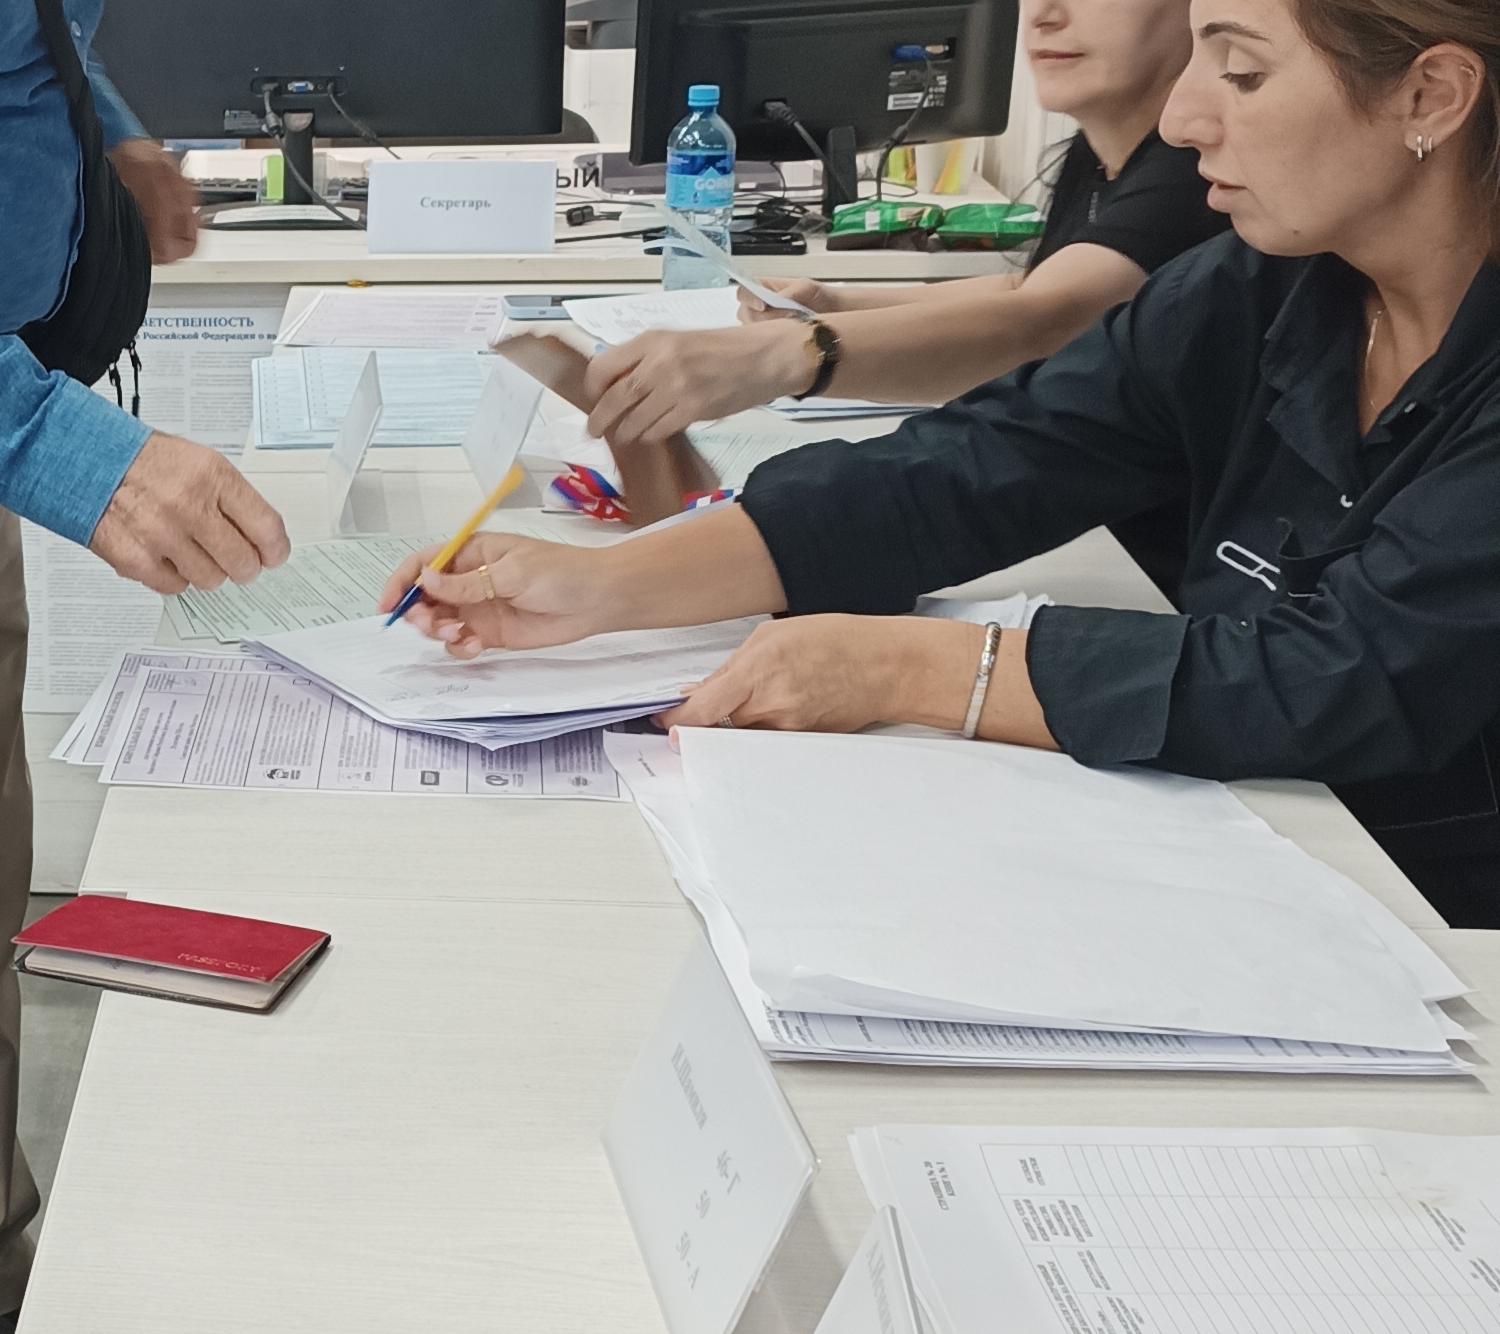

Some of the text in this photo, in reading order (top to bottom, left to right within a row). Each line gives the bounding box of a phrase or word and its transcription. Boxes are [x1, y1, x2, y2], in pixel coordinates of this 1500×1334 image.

[419, 196, 491, 212] Секретарь
[141, 317, 255, 328] ВЕТСТВЕННОСТЬ
[143, 332, 199, 340] Российской
[201, 333, 256, 342] Федерации
[929, 1177, 949, 1211] СТРАНИЦА
[941, 1174, 956, 1197] КНИГА
[695, 1189, 711, 1219] 50
